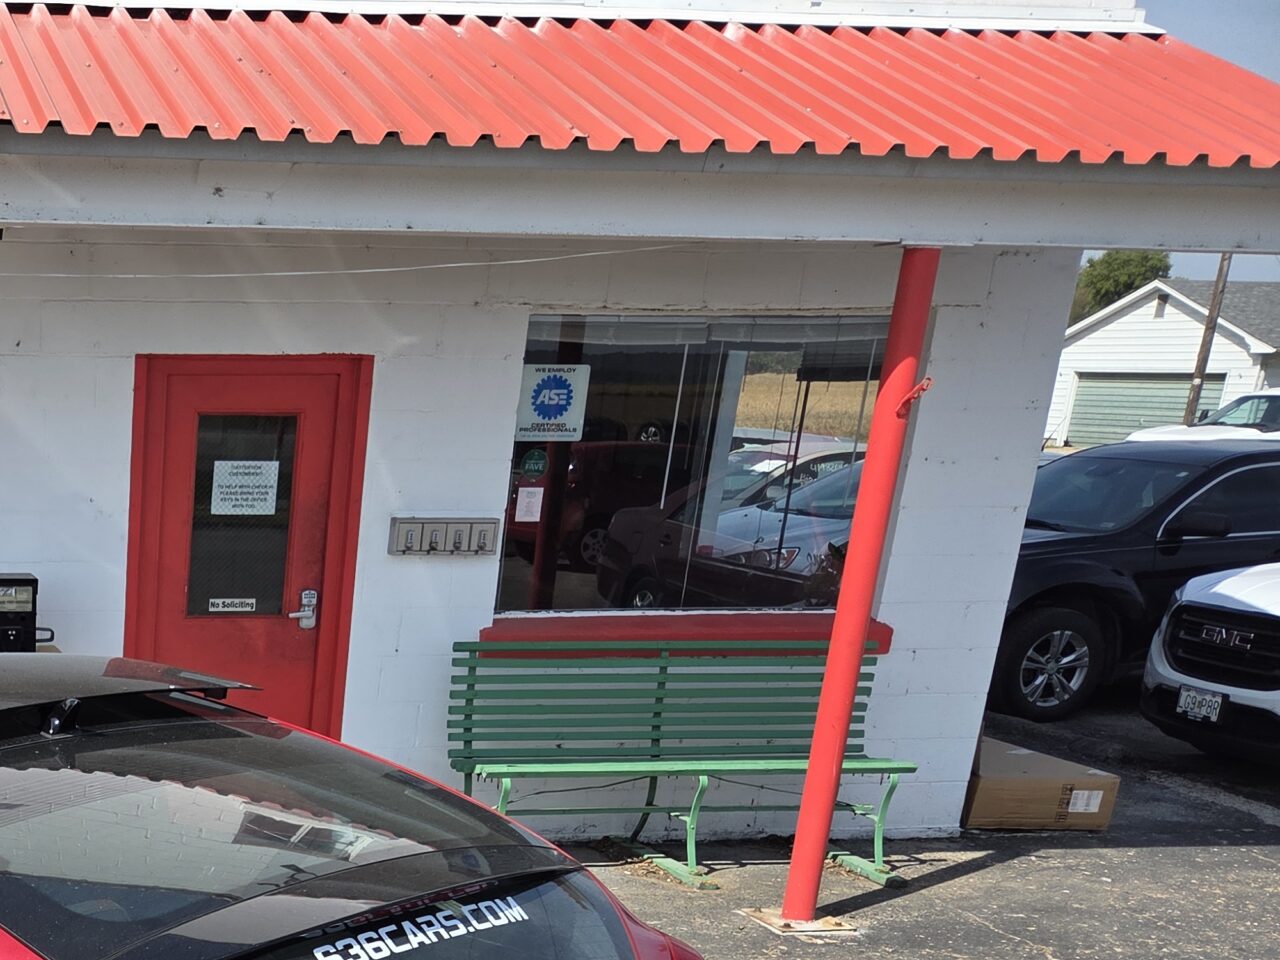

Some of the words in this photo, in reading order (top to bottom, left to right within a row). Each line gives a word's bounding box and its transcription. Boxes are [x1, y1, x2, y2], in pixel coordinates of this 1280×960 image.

[535, 389, 568, 405] ASE
[210, 601, 220, 609] No
[221, 600, 255, 610] Soliciting
[1202, 625, 1255, 650] GMC
